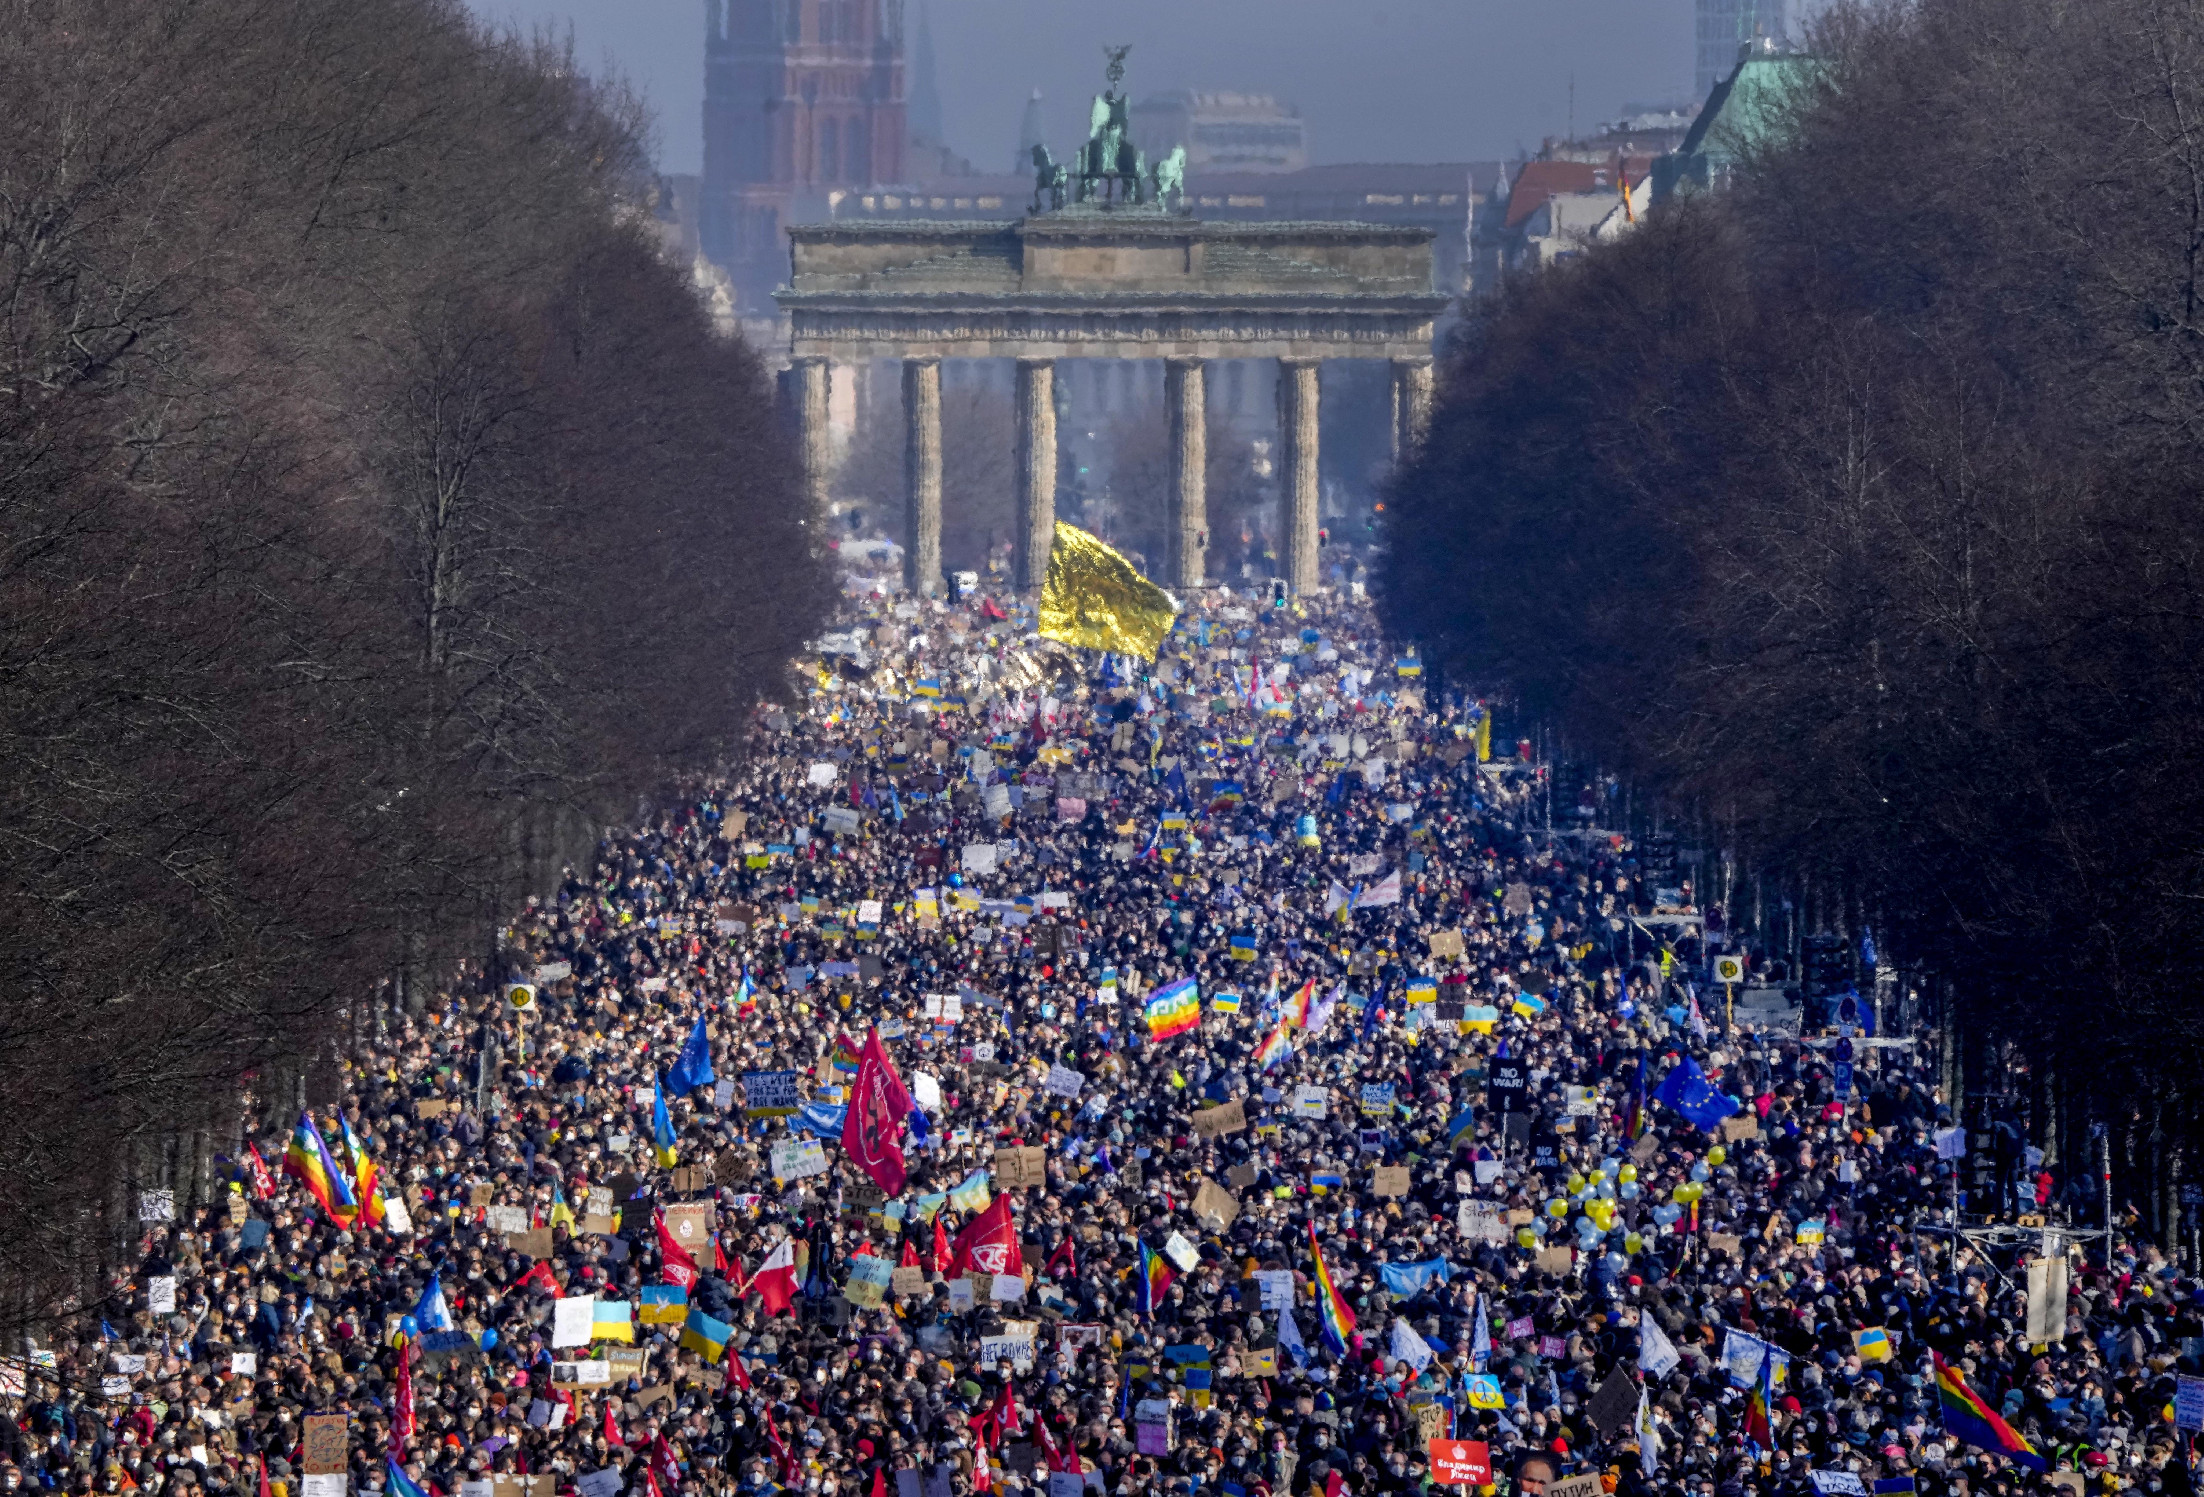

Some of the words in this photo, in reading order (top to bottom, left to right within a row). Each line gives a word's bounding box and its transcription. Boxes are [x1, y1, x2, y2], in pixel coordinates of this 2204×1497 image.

[1500, 1067, 1518, 1078] NO
[1493, 1078, 1524, 1088] WAR!
[1536, 1146, 1552, 1156] NO
[588, 1187, 613, 1203] STOP
[845, 1186, 882, 1201] STOP
[1421, 1406, 1440, 1425] STOP
[1550, 1482, 1593, 1497] ПУТИН
